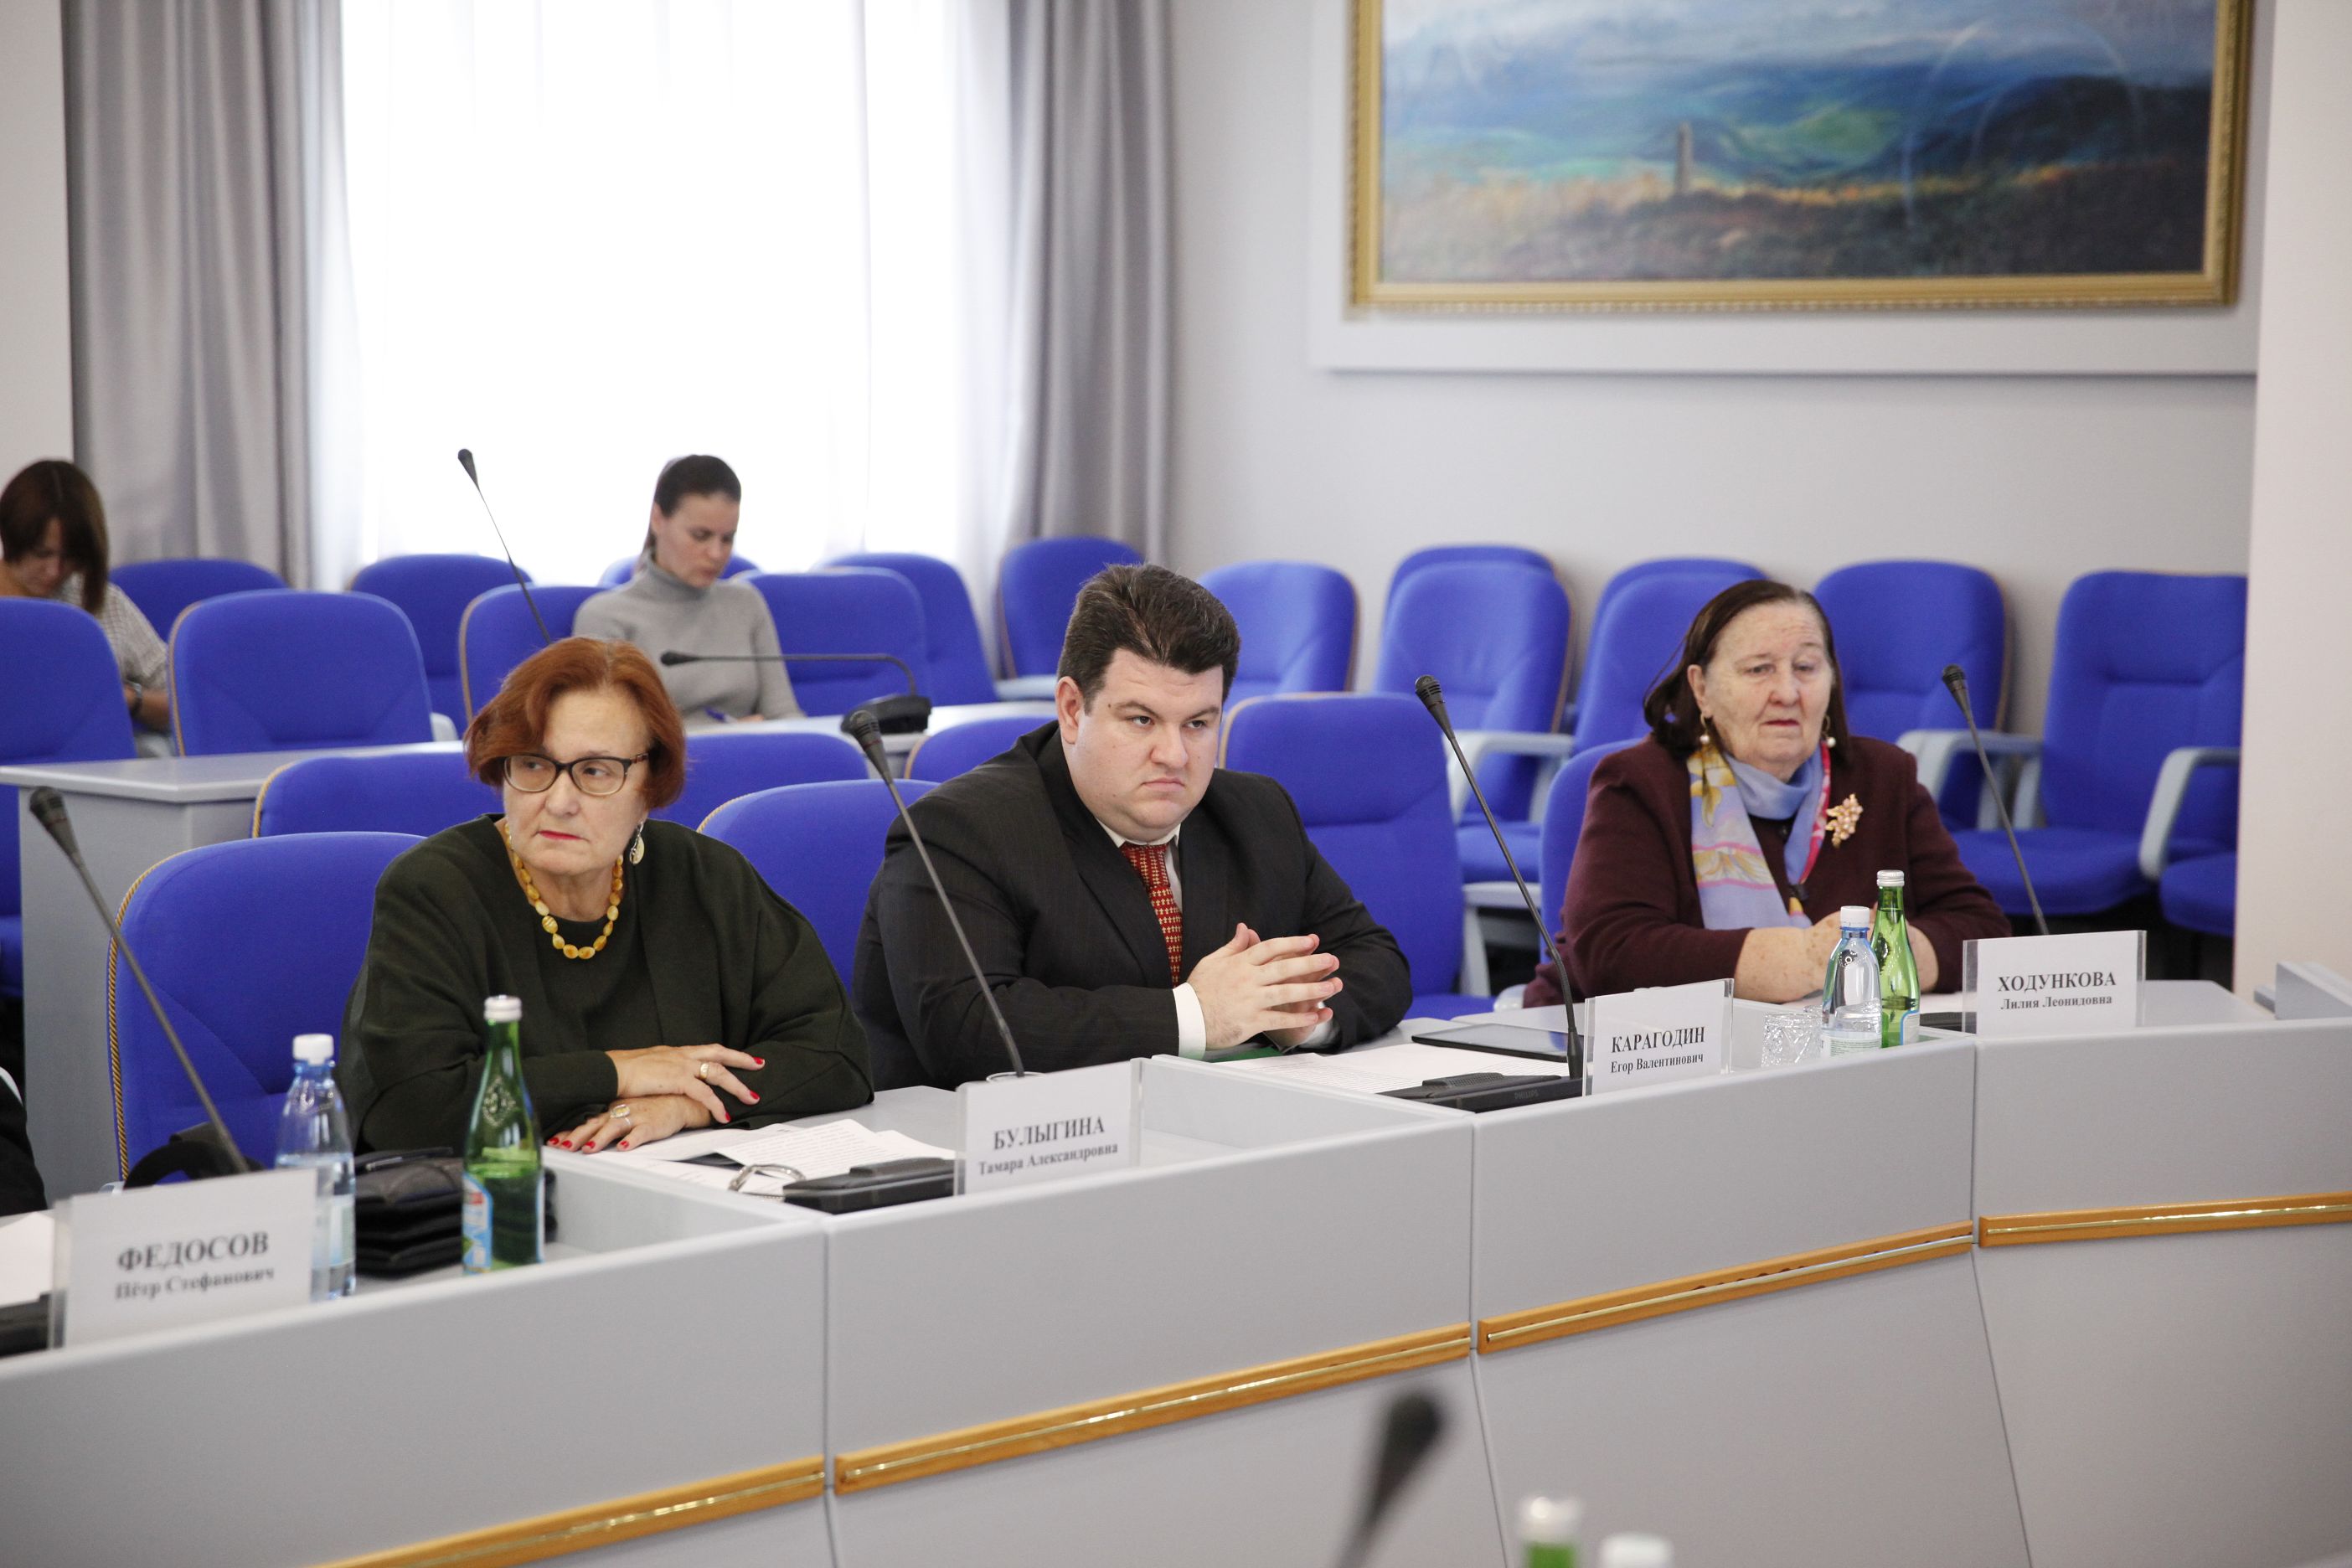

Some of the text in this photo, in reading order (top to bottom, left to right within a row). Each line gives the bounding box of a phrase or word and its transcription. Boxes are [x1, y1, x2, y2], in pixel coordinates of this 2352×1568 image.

[1997, 971, 2117, 993] ХОДУНКОВА
[2000, 995, 2113, 1011] Лилия Леонидовна
[1611, 1026, 1706, 1054] КАРАГОДИН
[1610, 1053, 1705, 1075] Егор Валентинович
[993, 1115, 1106, 1151] БУЛЫГИНА
[978, 1142, 1119, 1176] Тамара Александровна
[116, 1230, 269, 1271] ФЕДОСОВ
[114, 1266, 275, 1301] Пётр Стефанович
